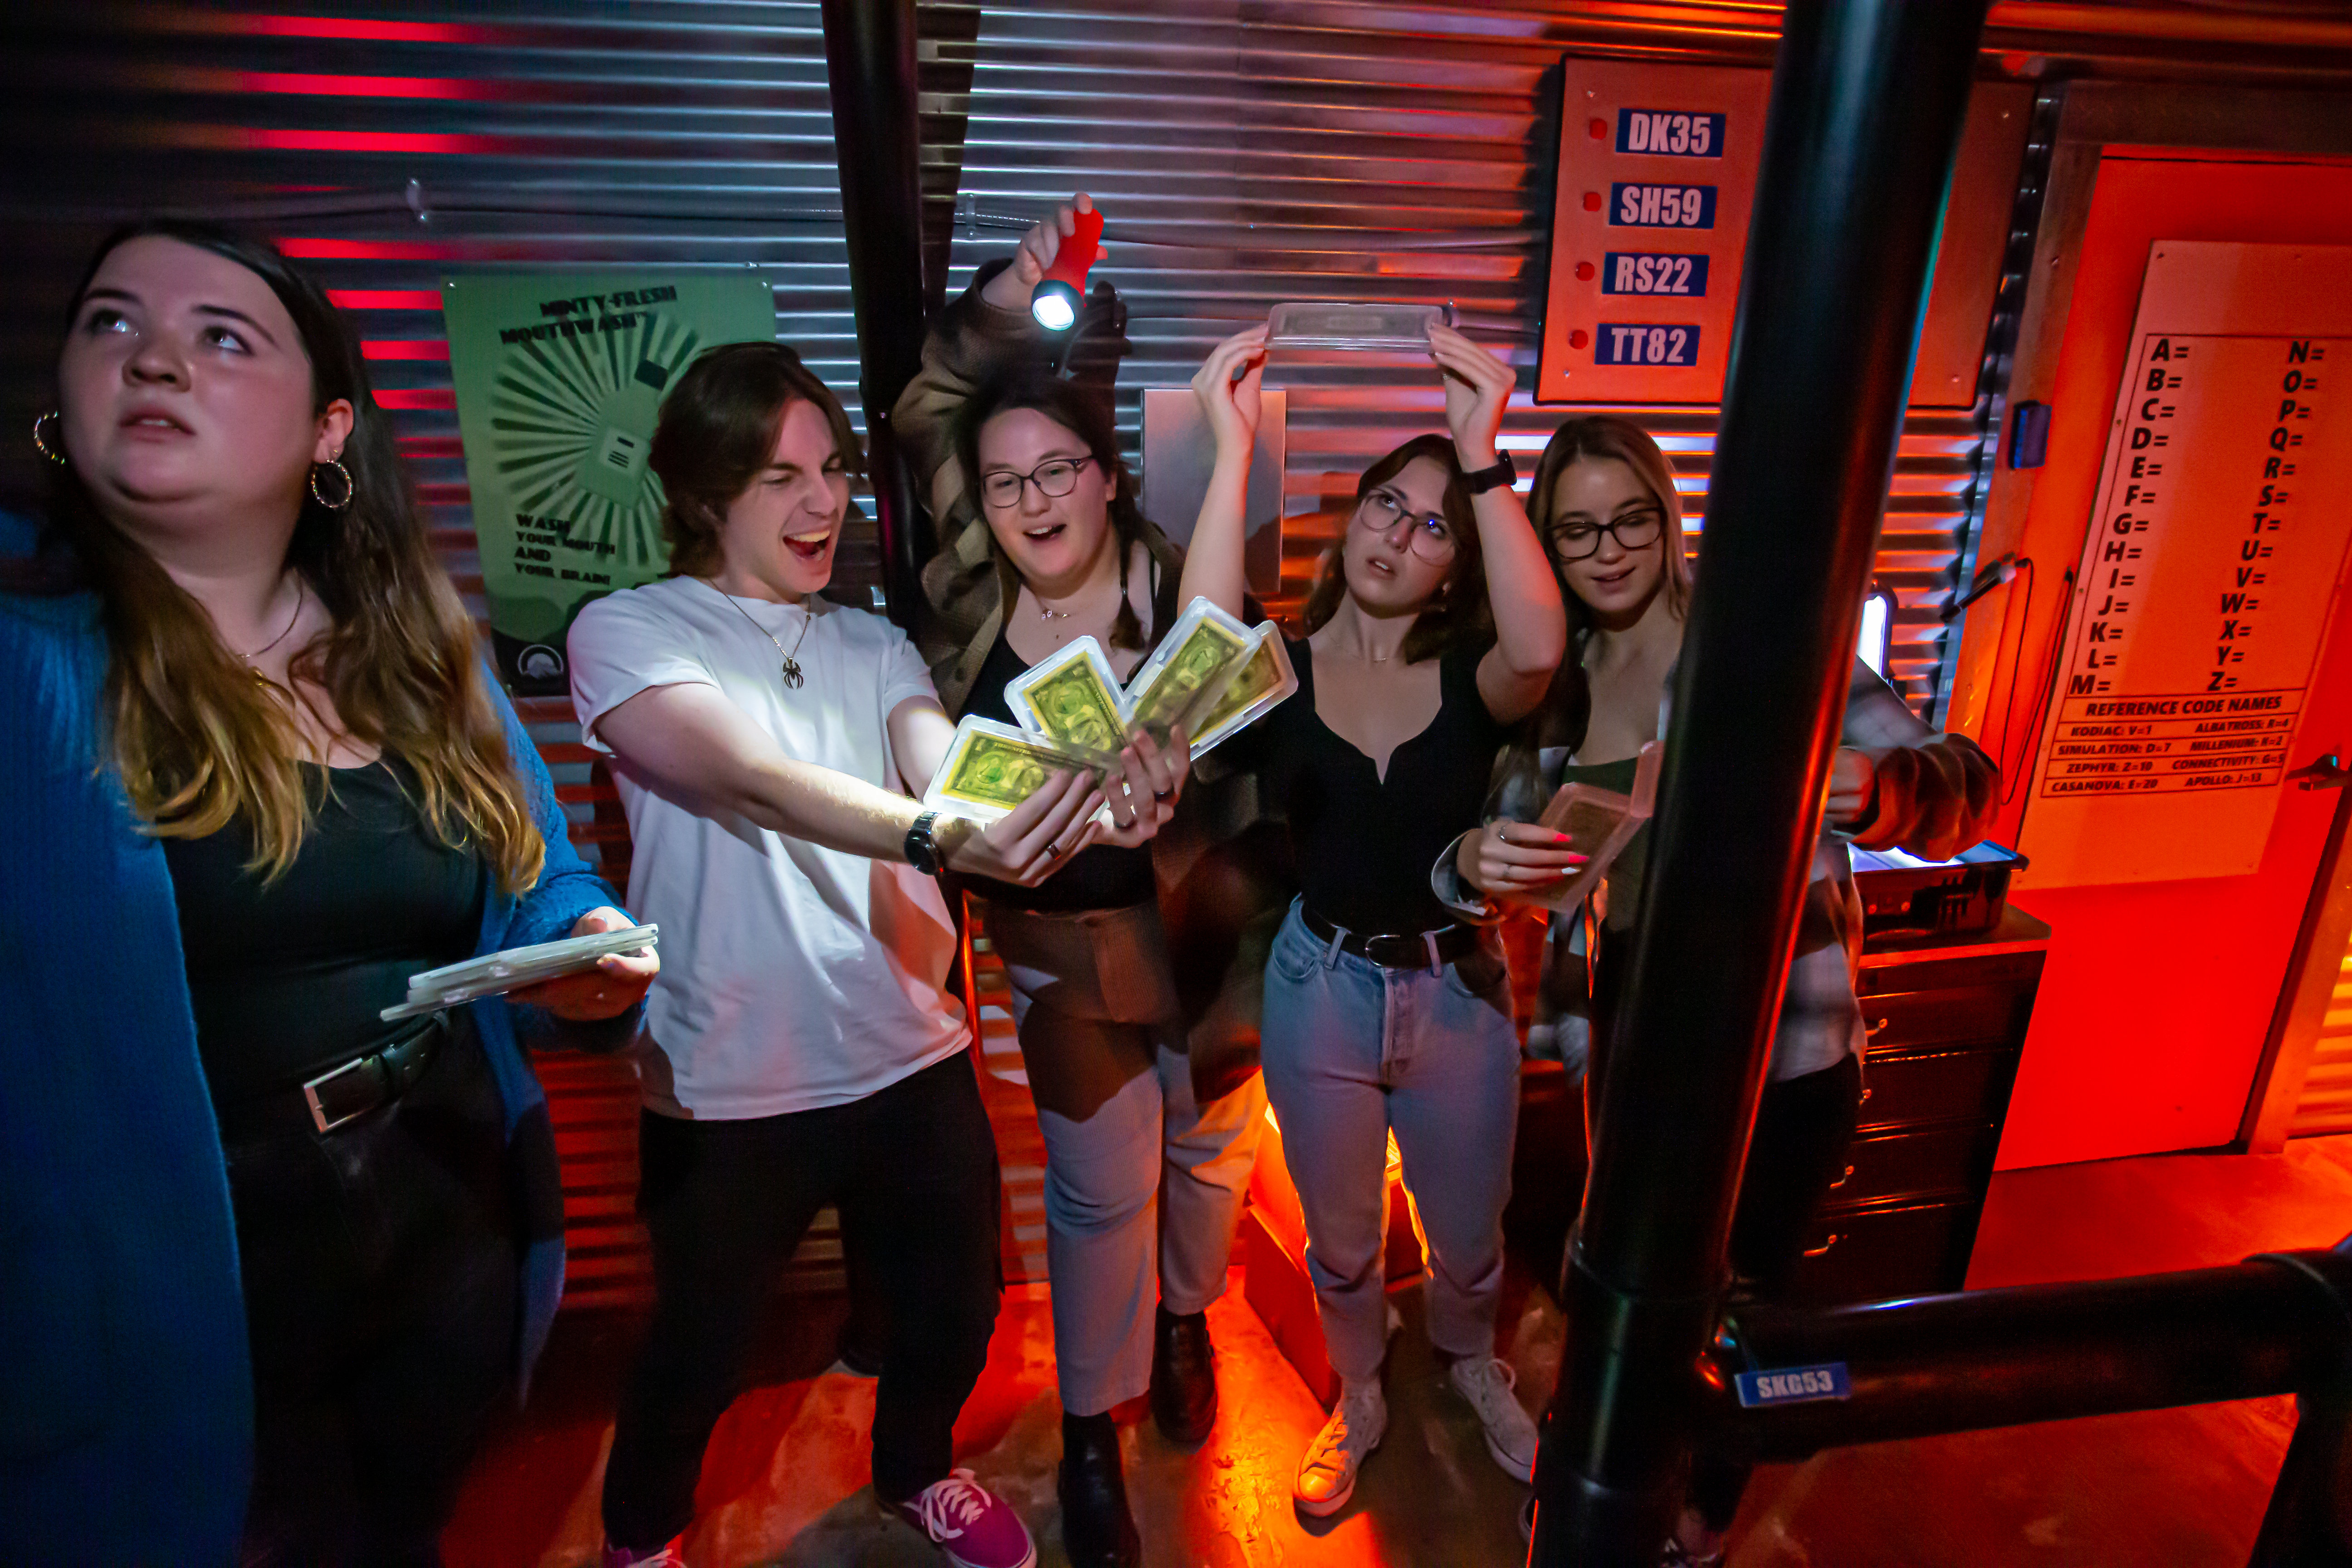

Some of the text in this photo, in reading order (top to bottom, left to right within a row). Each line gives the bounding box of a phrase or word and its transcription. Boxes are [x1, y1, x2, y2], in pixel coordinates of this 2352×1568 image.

[1627, 113, 1711, 155] DK35
[1620, 185, 1703, 226] SH59
[1614, 256, 1693, 294] RS22
[1611, 328, 1687, 363] TT82
[2150, 338, 2190, 362] A=
[2288, 340, 2325, 364] N=
[2146, 368, 2183, 392] B=
[2283, 369, 2318, 394] O=
[2141, 397, 2176, 421] C=
[2278, 399, 2311, 422] P=
[2131, 426, 2169, 450] D=
[2269, 426, 2303, 452] Q=
[2130, 456, 2163, 479] E=
[2263, 456, 2296, 479] R=
[2124, 484, 2156, 507] F=
[2258, 484, 2289, 507] S=
[516, 514, 571, 533] WASH
[2113, 512, 2149, 535] G=
[2253, 512, 2281, 534] T=
[516, 531, 616, 554] YOUR MOUTH
[2104, 541, 2142, 562] H=
[2241, 539, 2274, 561] U=
[514, 546, 551, 562] AND
[514, 563, 555, 578] YOUR
[2109, 568, 2136, 589] I=
[2237, 567, 2266, 588] V=
[2097, 594, 2129, 616] J=
[2221, 593, 2259, 614] W=
[2089, 622, 2123, 643] K=
[2219, 619, 2252, 641] X=
[2087, 648, 2117, 669] L=
[2218, 645, 2245, 666] Y=
[2069, 674, 2111, 695] M=
[2207, 671, 2238, 692] Z=
[2086, 696, 2283, 716] REFERENCE CODE NAMES
[2071, 726, 2124, 737] KODIAC:
[2195, 720, 2264, 733] ALBATROSS:
[2058, 744, 2142, 755] SIMULATION:
[2067, 762, 2119, 774] ZEPHYR:
[2171, 755, 2259, 770] CONNECTIVITY:
[2052, 780, 2125, 792] CASANOVA:
[2184, 774, 2234, 787] APOLLO:
